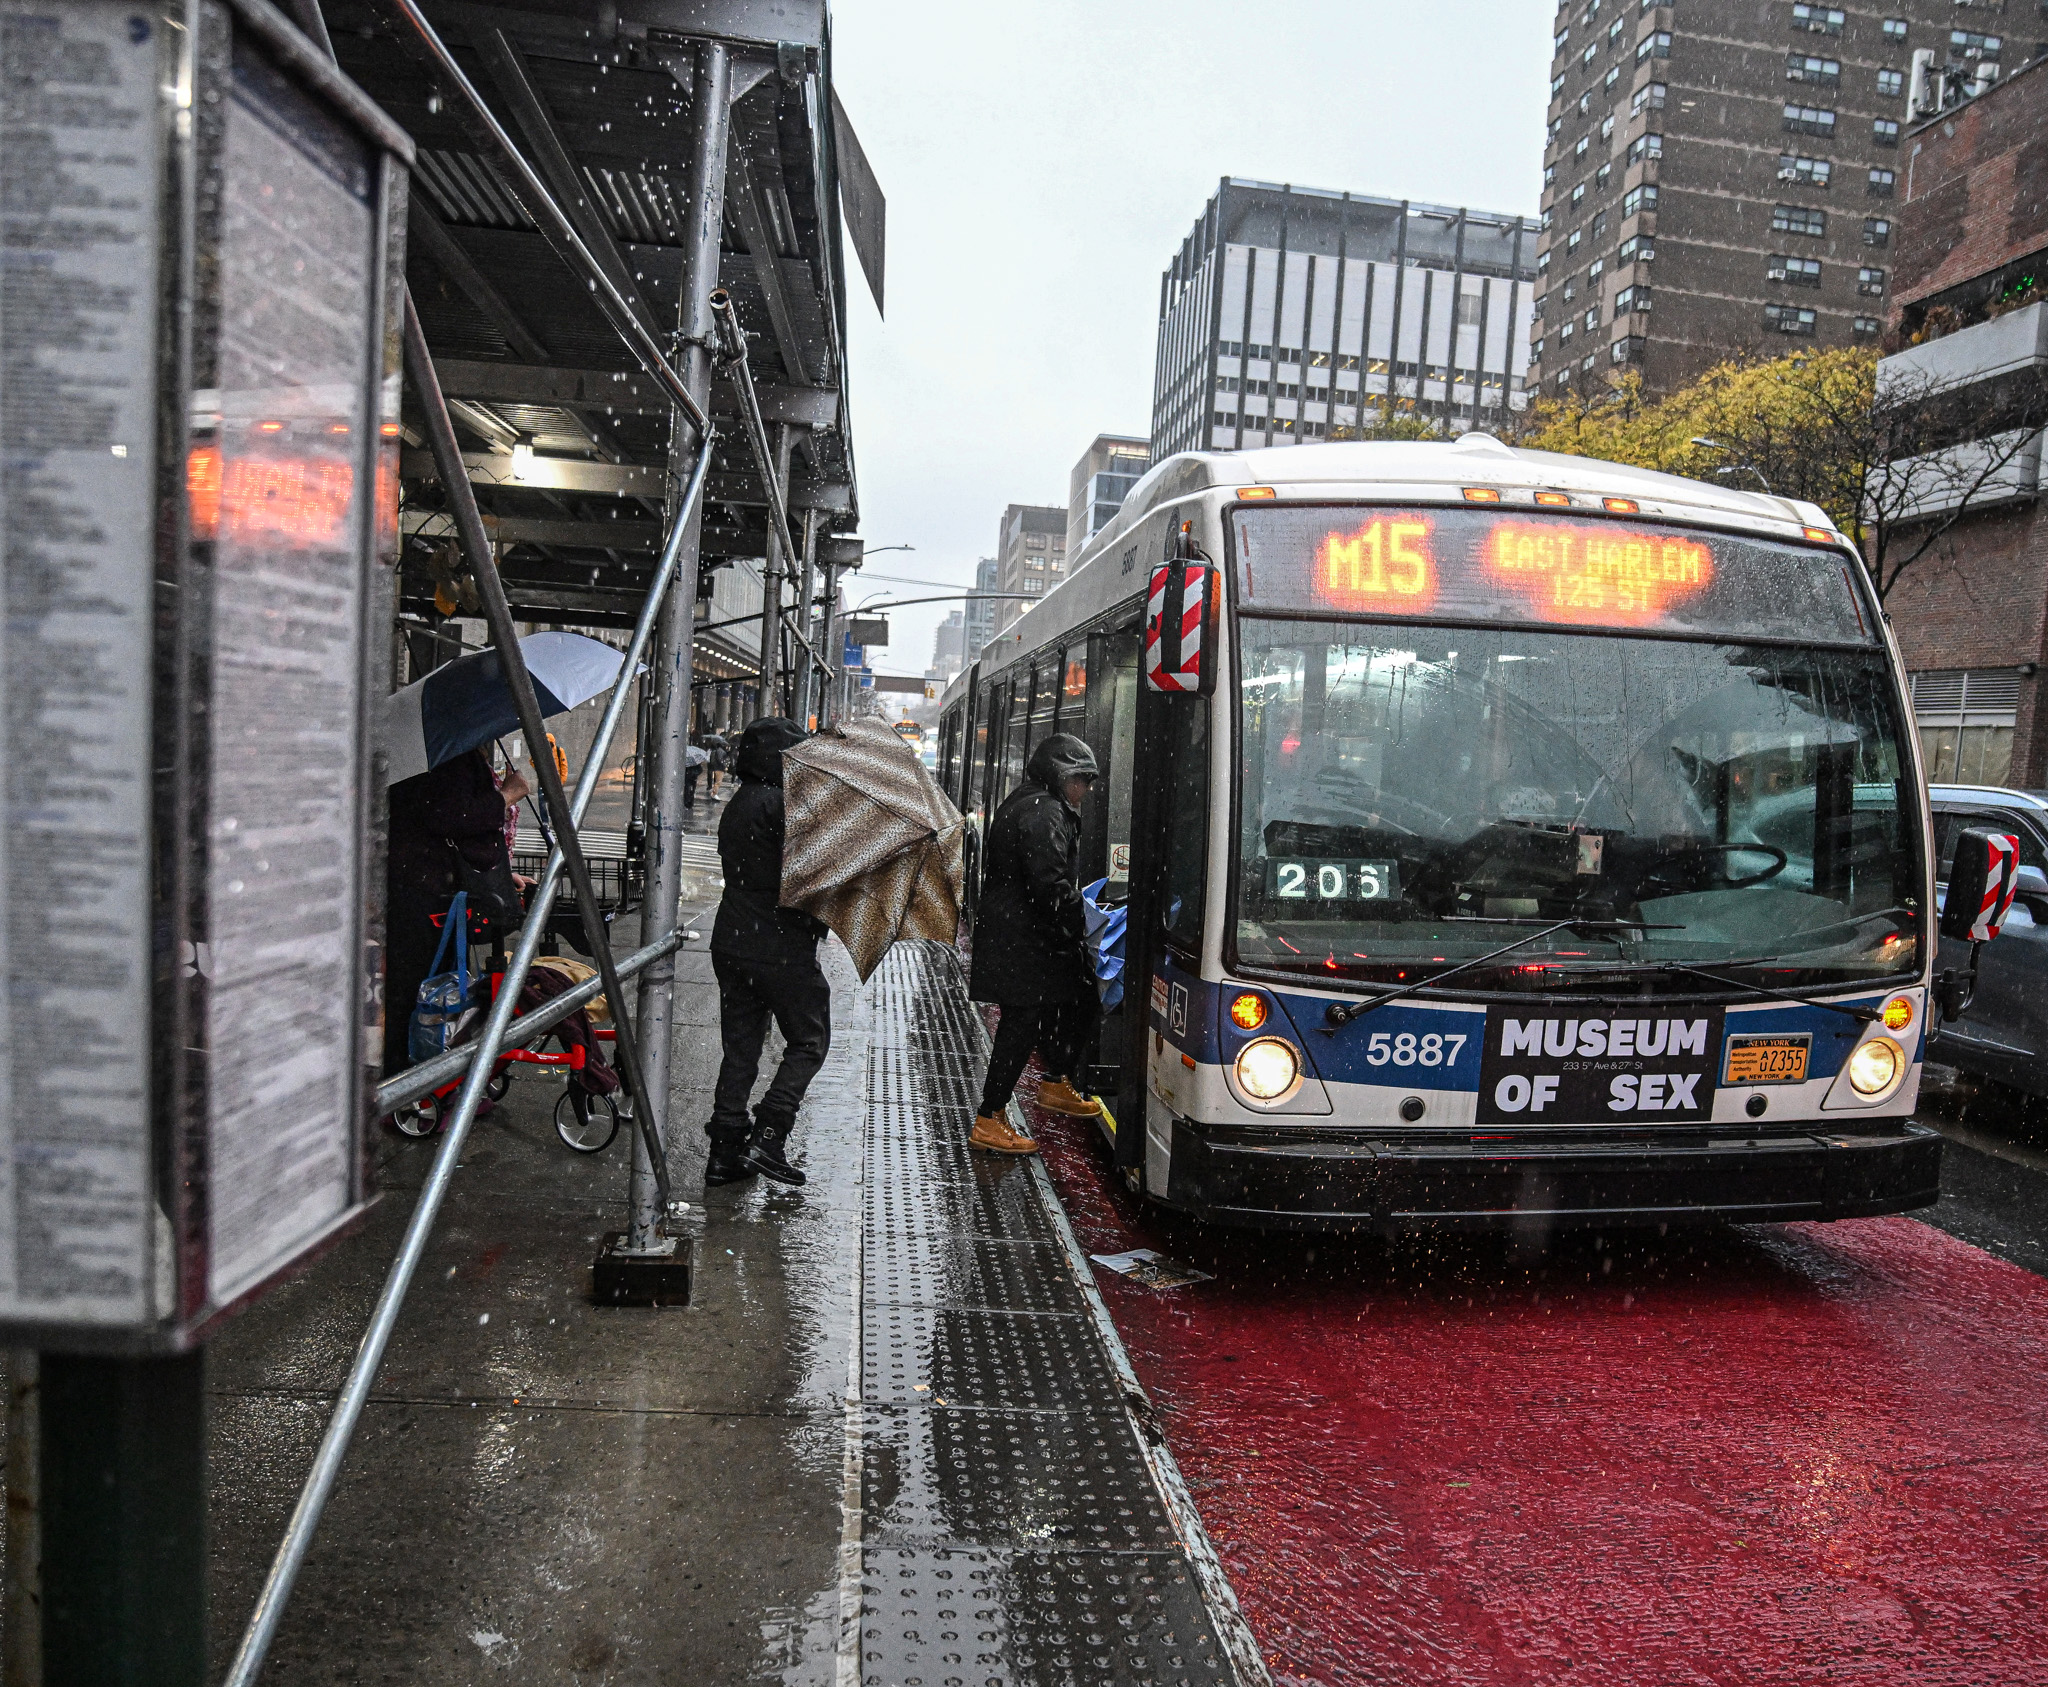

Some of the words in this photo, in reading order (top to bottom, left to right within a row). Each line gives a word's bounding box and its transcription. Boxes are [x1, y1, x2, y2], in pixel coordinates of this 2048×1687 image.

[1329, 521, 1426, 594] M15
[1499, 531, 1571, 571] EAST
[1586, 539, 1699, 583] HARLEM
[1554, 574, 1603, 608] 125
[1618, 578, 1651, 612] ST
[1366, 1032, 1467, 1067] 5887
[1500, 1018, 1709, 1058] MUSEUM
[1769, 1039, 1790, 1047] YORK
[1562, 1061, 1580, 1070] 233
[1593, 1061, 1609, 1070] Ave
[1634, 1061, 1643, 1070] St
[1494, 1074, 1560, 1113] OF
[1607, 1073, 1702, 1112] SEX
